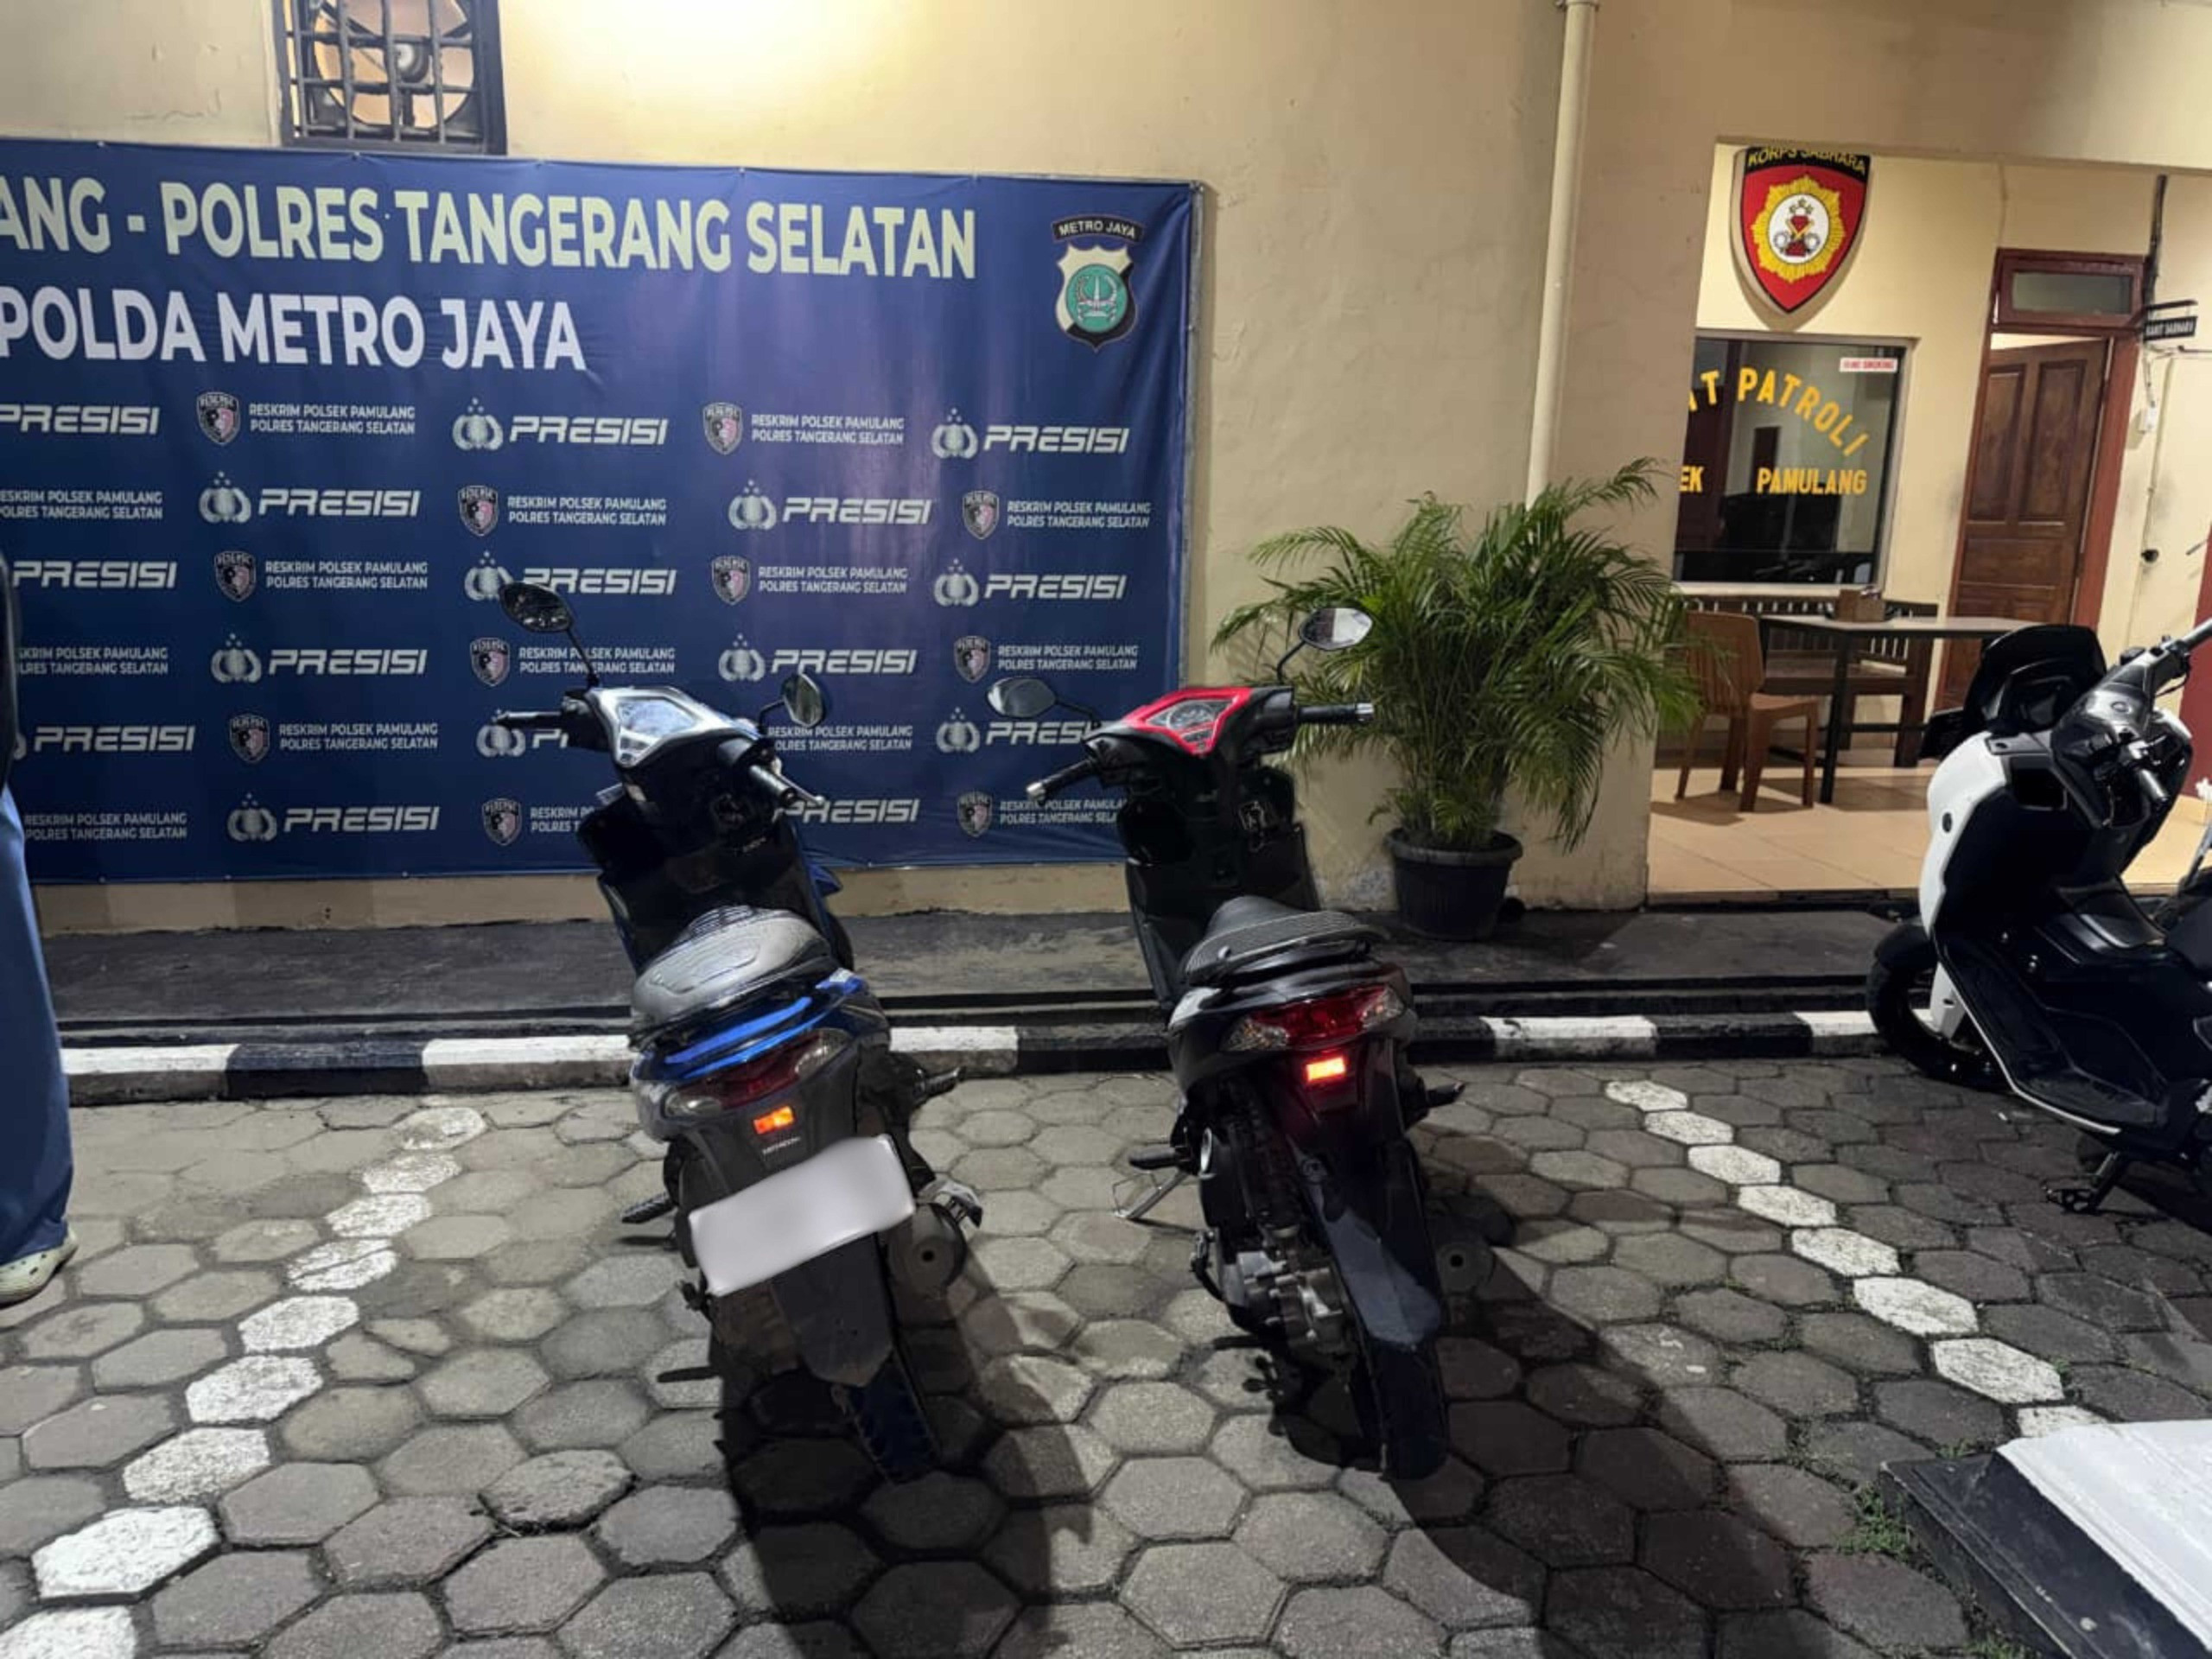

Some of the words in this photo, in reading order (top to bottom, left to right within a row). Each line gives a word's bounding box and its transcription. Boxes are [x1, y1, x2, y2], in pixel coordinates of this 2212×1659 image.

[0, 176, 111, 253] ANG
[128, 214, 145, 232] -
[161, 181, 383, 262] POLRES
[395, 191, 731, 273] TANGERANG
[746, 200, 976, 278] SELATAN
[1058, 220, 1103, 236] METRO
[1106, 222, 1135, 238] JAYA
[0, 286, 207, 361] POLDA
[218, 292, 424, 368] METRO
[441, 299, 586, 371] JAYA
[249, 404, 300, 416] RESKRIM
[303, 404, 347, 417] POLSEK
[350, 406, 415, 419] PAMULANG
[1738, 367, 1869, 456] PATROLI
[0, 404, 160, 435] PRESISI
[251, 419, 293, 432] POLRES
[296, 420, 363, 433] TANGERANG
[366, 421, 416, 434] SELATAN
[751, 414, 798, 428] RESKRIM
[801, 415, 842, 429] POLSEK
[845, 417, 904, 429] PAMULANG
[510, 416, 669, 445] PRESISI
[752, 429, 792, 442] POLRES
[795, 430, 857, 443] TANGERANG
[859, 431, 904, 444] SELATAN
[983, 425, 1129, 454] PRESISI
[1679, 465, 1704, 493] EK
[1757, 467, 1867, 495] PAMULANG
[48, 490, 94, 504] POLSEK
[96, 491, 162, 504] PAMULANG
[258, 488, 421, 516] PRESISI
[507, 495, 556, 509] RESKRIM
[560, 496, 602, 510] POLSEK
[606, 498, 666, 511] PAMULANG
[42, 506, 110, 518] TANGERANG
[112, 506, 162, 519] SELATAN
[783, 497, 931, 524] PRESISI
[1007, 500, 1052, 513] RESKRIM
[1054, 501, 1093, 513] POLSEK
[1096, 502, 1151, 514] PAMULANG
[509, 511, 550, 524] POLRES
[553, 512, 618, 525] TANGERANG
[620, 512, 666, 526] SELATAN
[1007, 516, 1045, 528] POLRES
[1047, 516, 1105, 529] TANGERANG
[1107, 517, 1149, 529] SELATAN
[12, 561, 177, 588] PRESISI
[265, 561, 315, 574] RESKRIM
[319, 561, 362, 575] POLSEK
[365, 562, 427, 575] PAMULANG
[758, 566, 805, 578] RESKRIM
[808, 567, 847, 579] POLSEK
[849, 567, 907, 580] PAMULANG
[266, 576, 309, 589] POLRES
[313, 576, 377, 589] TANGERANG
[380, 576, 427, 589] SELATAN
[524, 568, 677, 595] PRESISI
[759, 580, 798, 593] POLRES
[801, 581, 861, 594] TANGERANG
[863, 581, 906, 594] SELATAN
[984, 574, 1127, 600] PRESISI
[55, 647, 101, 660] POLSEK
[104, 647, 168, 660] PAMULANG
[519, 647, 568, 660] RESKRIM
[570, 647, 612, 660] PLSEK
[614, 647, 676, 660] PAMULANG
[998, 645, 1040, 657] RESKRIM
[1044, 645, 1082, 657] POLSEK
[1084, 645, 1139, 658] PAMULANG
[50, 662, 118, 675] TANGERANG
[120, 662, 168, 675] SELATAN
[269, 649, 428, 675] PRESISI
[520, 661, 561, 674] POLRES
[629, 661, 676, 674] SELATAN
[772, 649, 918, 674] PRESISI
[998, 659, 1035, 671] POLRES
[1037, 659, 1094, 671] TANGERANG
[1096, 659, 1137, 671] SELATAN
[279, 723, 327, 736] RESKRIM
[331, 723, 373, 735] POLSEK
[376, 722, 438, 735] PAMULANG
[767, 726, 813, 738] RESKRIM
[816, 725, 854, 738] POLSEK
[856, 725, 913, 737] PAMULANG
[985, 721, 1091, 745] PRES
[34, 725, 196, 753] PRESISI
[280, 738, 321, 750] POLRES
[325, 738, 388, 750] TANGERANG
[391, 737, 438, 749] SELATAN
[774, 739, 806, 751] OLRES
[809, 739, 867, 751] TANGERANG
[869, 738, 912, 751] SELATAN
[1045, 799, 1082, 810] POLSEK
[24, 813, 73, 826] RESKRIM
[77, 812, 120, 825] POLSEK
[124, 811, 187, 825] PAMULANG
[284, 806, 440, 832] PRESISI
[531, 806, 578, 819] RESKRIM
[1000, 813, 1036, 824] POLRES
[1038, 812, 1094, 823] TANGERANG
[26, 828, 68, 841] POLRES
[71, 827, 137, 840] TANGERANG
[139, 827, 187, 839] SELATAN
[532, 821, 570, 832] POLRES
